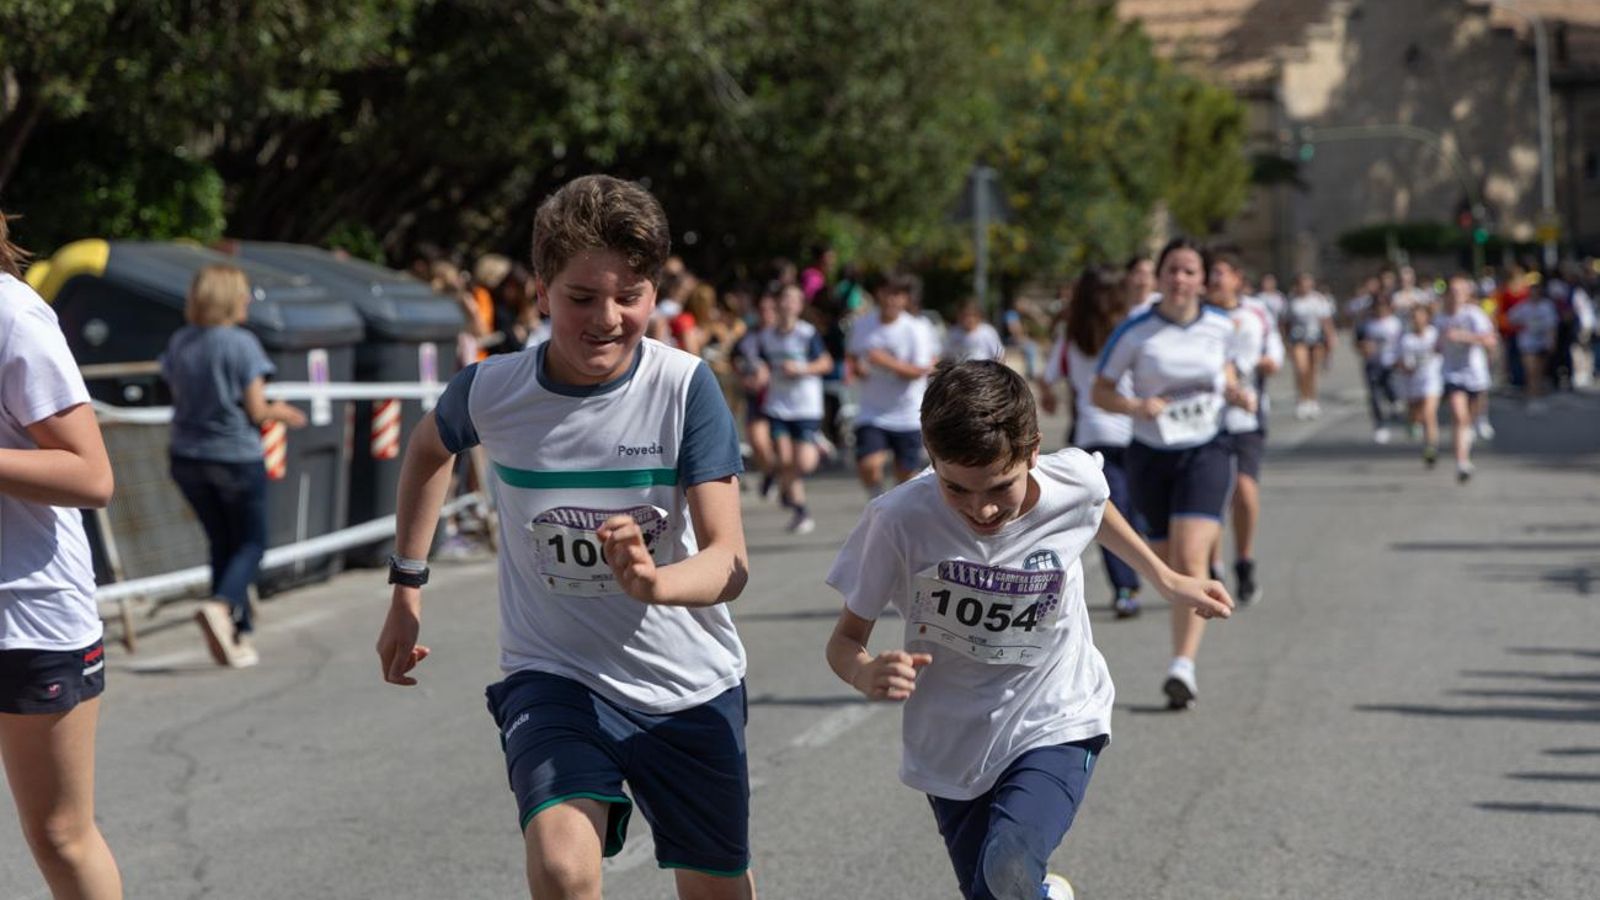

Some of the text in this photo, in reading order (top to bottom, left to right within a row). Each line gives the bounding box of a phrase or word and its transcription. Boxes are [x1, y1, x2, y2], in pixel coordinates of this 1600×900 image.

[618, 442, 663, 456] Poveda
[1000, 581, 1049, 593] LA GLORIA
[932, 590, 1040, 632] 1054
